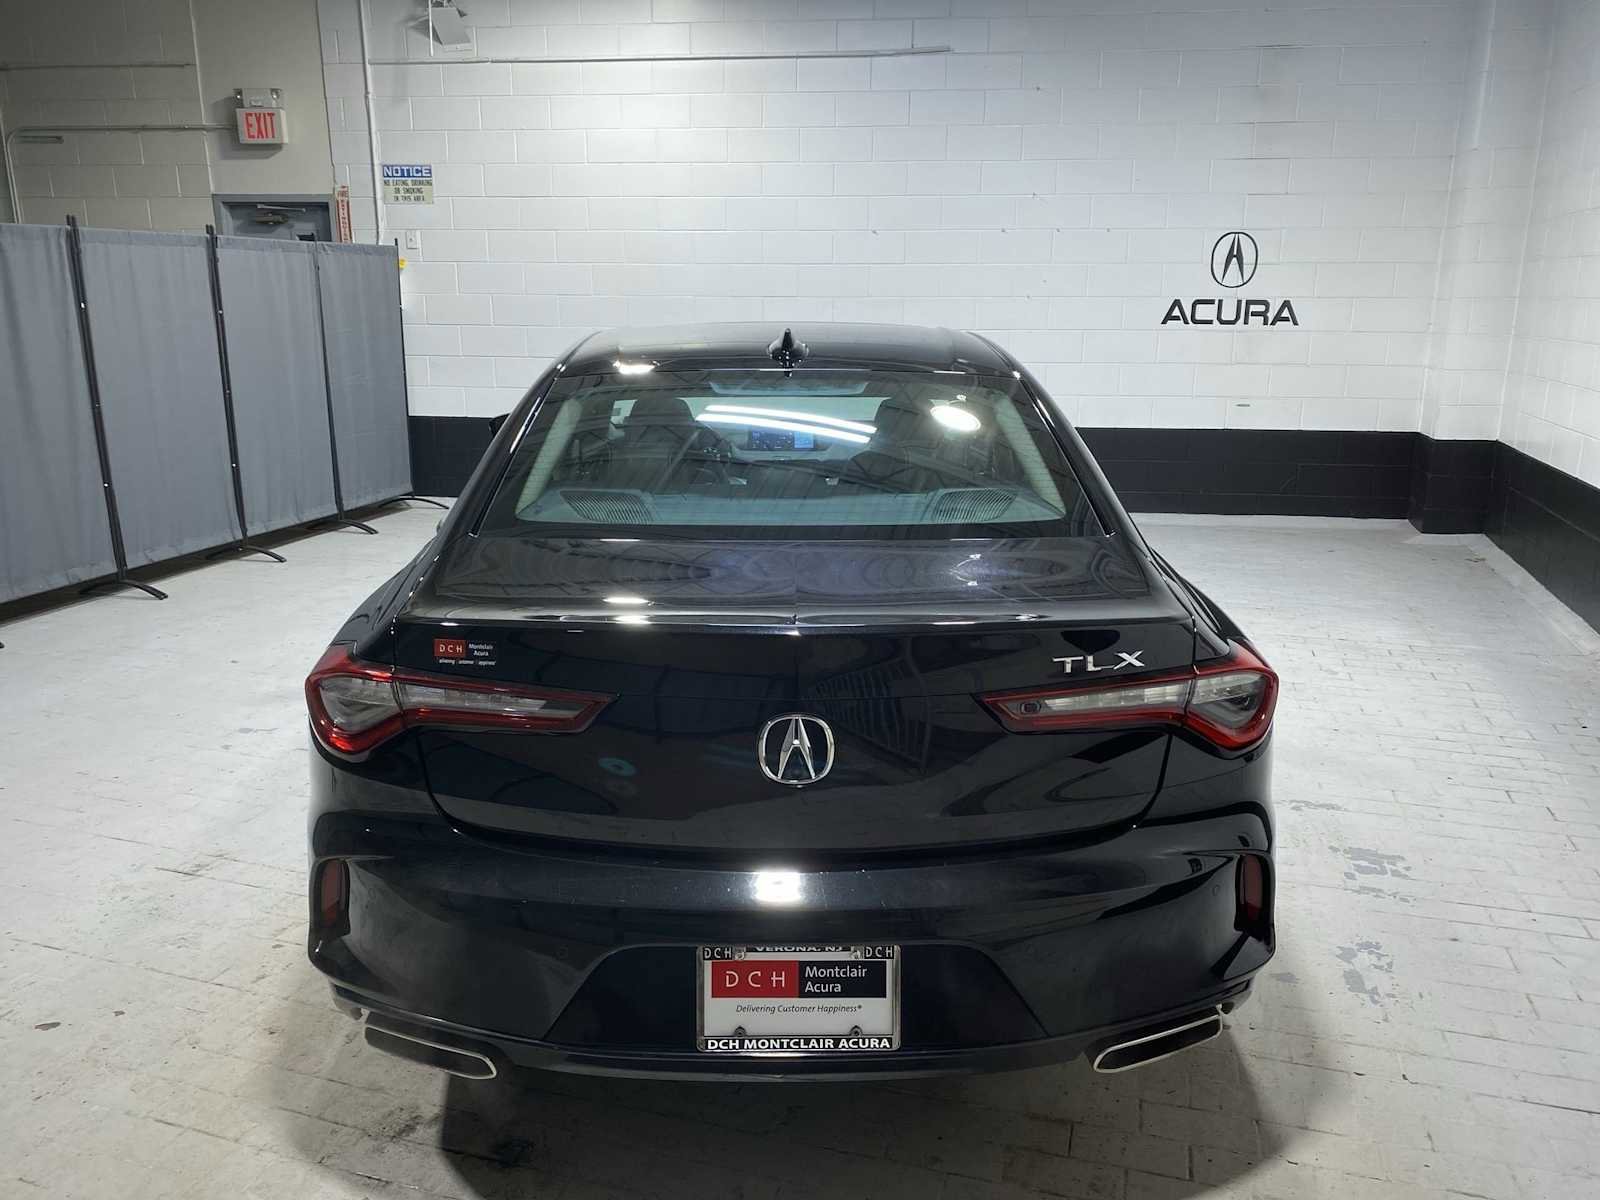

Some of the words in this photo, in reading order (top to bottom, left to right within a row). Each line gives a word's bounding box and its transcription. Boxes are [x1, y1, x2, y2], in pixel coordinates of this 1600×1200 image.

[244, 111, 276, 139] EXIT
[383, 166, 432, 177] NOTICE
[1161, 299, 1299, 326] ACURA
[439, 644, 463, 654] DCH
[1052, 650, 1145, 673] TLX
[705, 947, 732, 959] DCH
[865, 947, 894, 958] DCH
[804, 965, 868, 978] Montclair
[725, 971, 785, 988] DCH
[804, 982, 842, 993] Acura
[736, 1004, 776, 1015] Delivering
[777, 1004, 816, 1013] Customer
[707, 1039, 740, 1050] DCH
[744, 1038, 835, 1049] MONTCLAIR
[839, 1038, 891, 1049] ACURA
